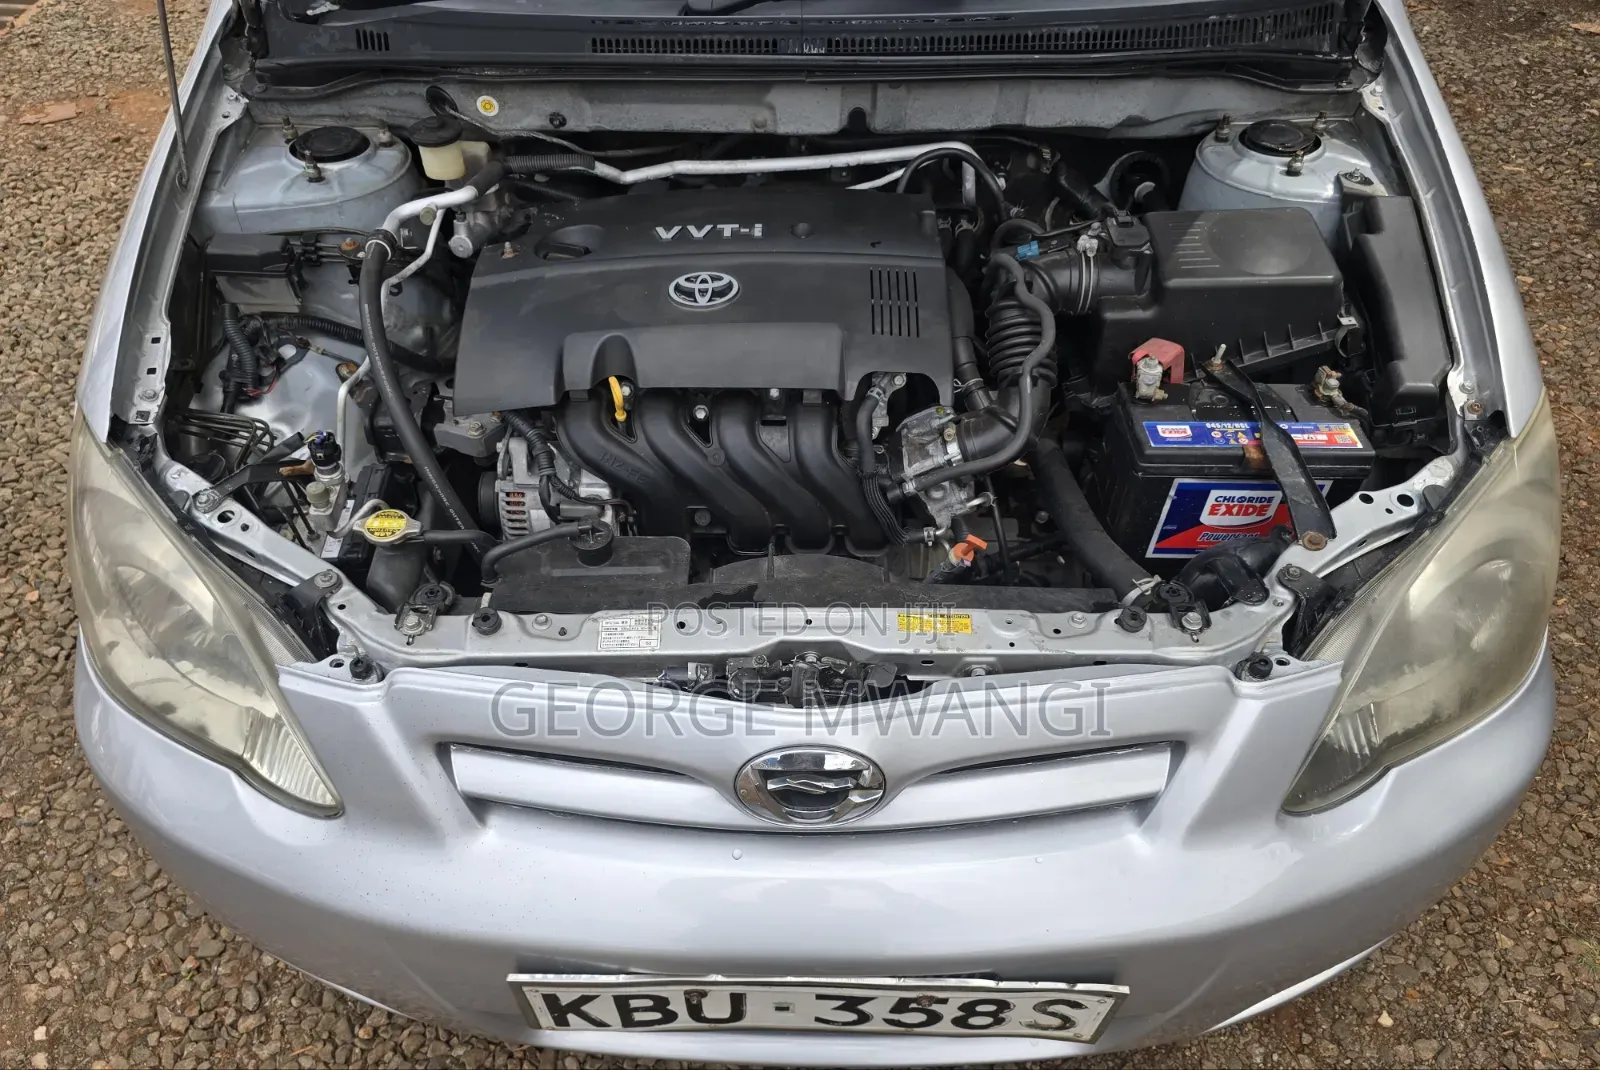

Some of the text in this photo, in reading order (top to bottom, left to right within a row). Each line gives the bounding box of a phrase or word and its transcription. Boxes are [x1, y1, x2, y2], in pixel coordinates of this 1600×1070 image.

[654, 223, 763, 240] VVT-i
[1214, 495, 1275, 504] CHLORIDE
[1207, 504, 1272, 516] EXIDE
[541, 989, 747, 1028] KBU
